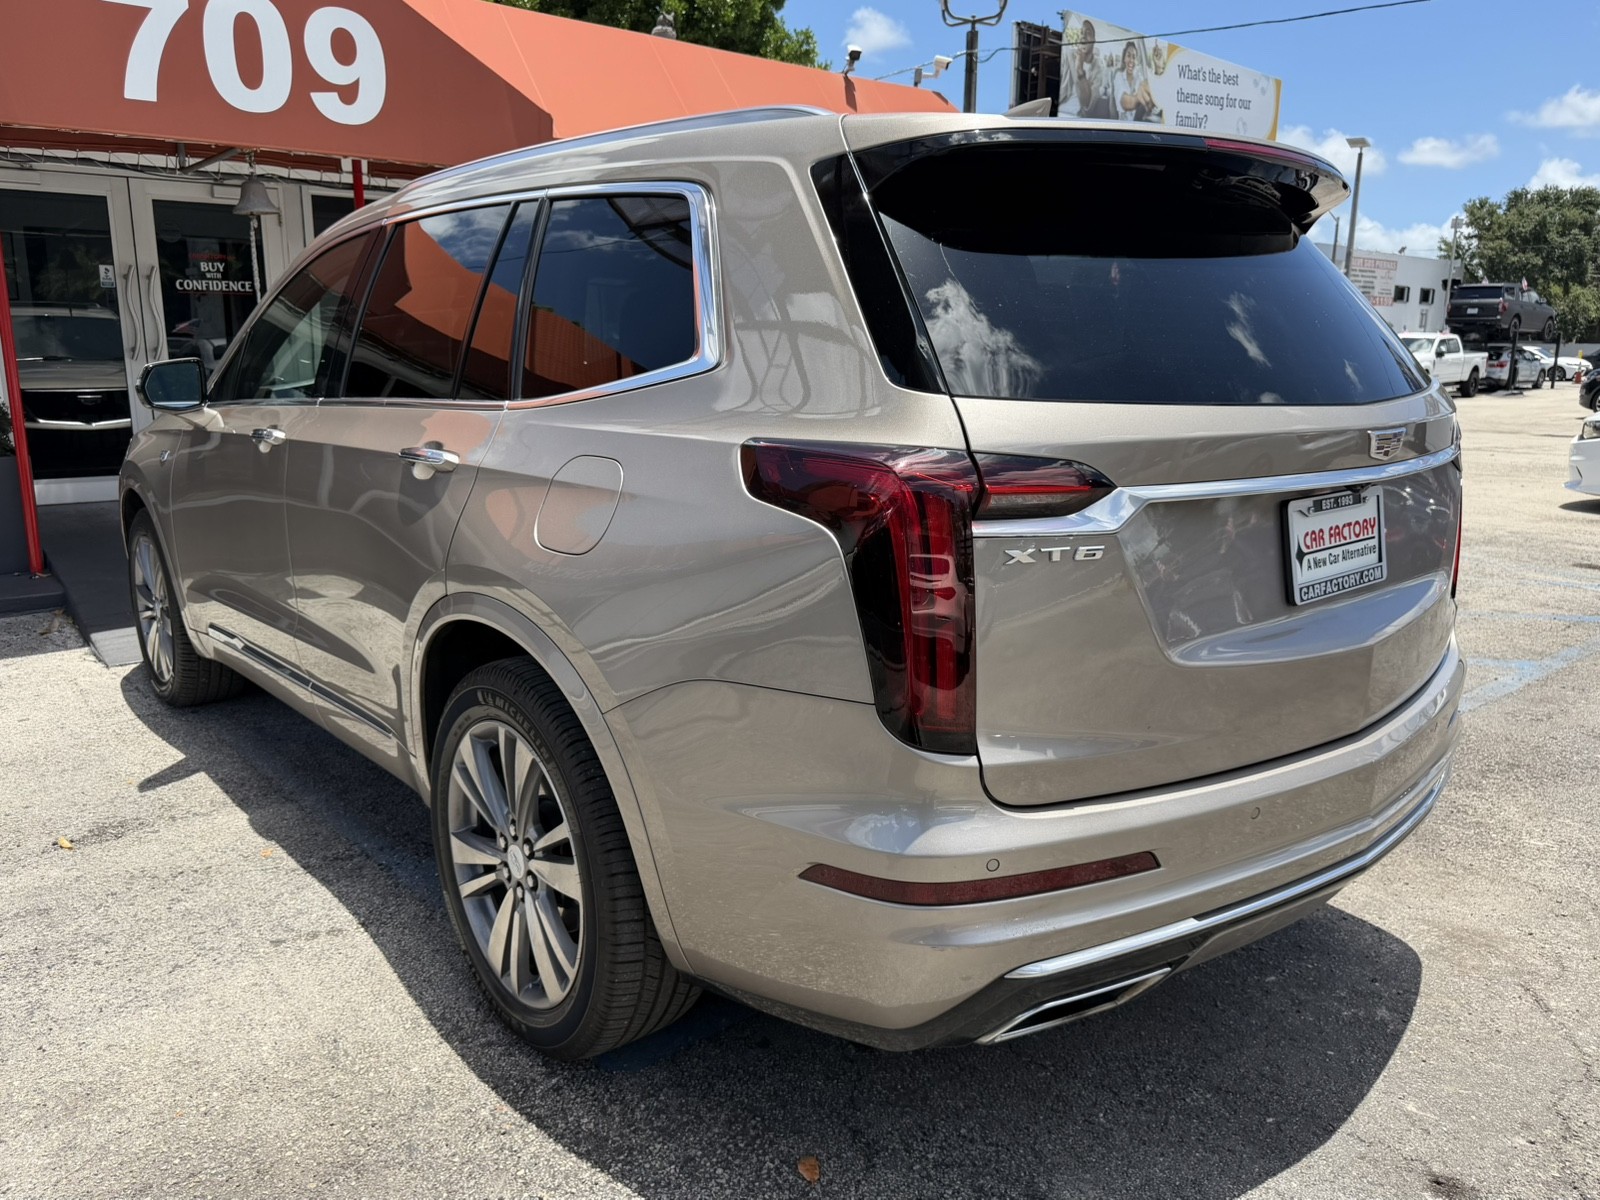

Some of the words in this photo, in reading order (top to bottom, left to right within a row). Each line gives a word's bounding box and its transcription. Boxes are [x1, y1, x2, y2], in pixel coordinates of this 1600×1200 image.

[103, 0, 387, 125] 709
[1177, 64, 1207, 82] What's
[1208, 68, 1221, 84] the
[1222, 70, 1239, 86] best
[1176, 88, 1203, 105] theme
[1204, 94, 1224, 110] song
[1225, 93, 1237, 108] for
[1238, 99, 1251, 110] our
[1175, 111, 1208, 129] family?
[200, 262, 225, 272] BUY
[175, 279, 253, 292] CONFIDENCE
[1321, 498, 1337, 510] EST.
[1338, 495, 1353, 507] 1993
[1303, 528, 1325, 550] CAR
[1328, 517, 1376, 545] FACTORY
[1003, 545, 1105, 565] XT6
[1306, 558, 1312, 571] A
[1313, 556, 1327, 569] New
[1328, 552, 1340, 566] Car
[1341, 544, 1377, 562] Alternative
[1301, 567, 1382, 600] CARFACTORY.COM
[495, 697, 552, 760] MICHELIN
